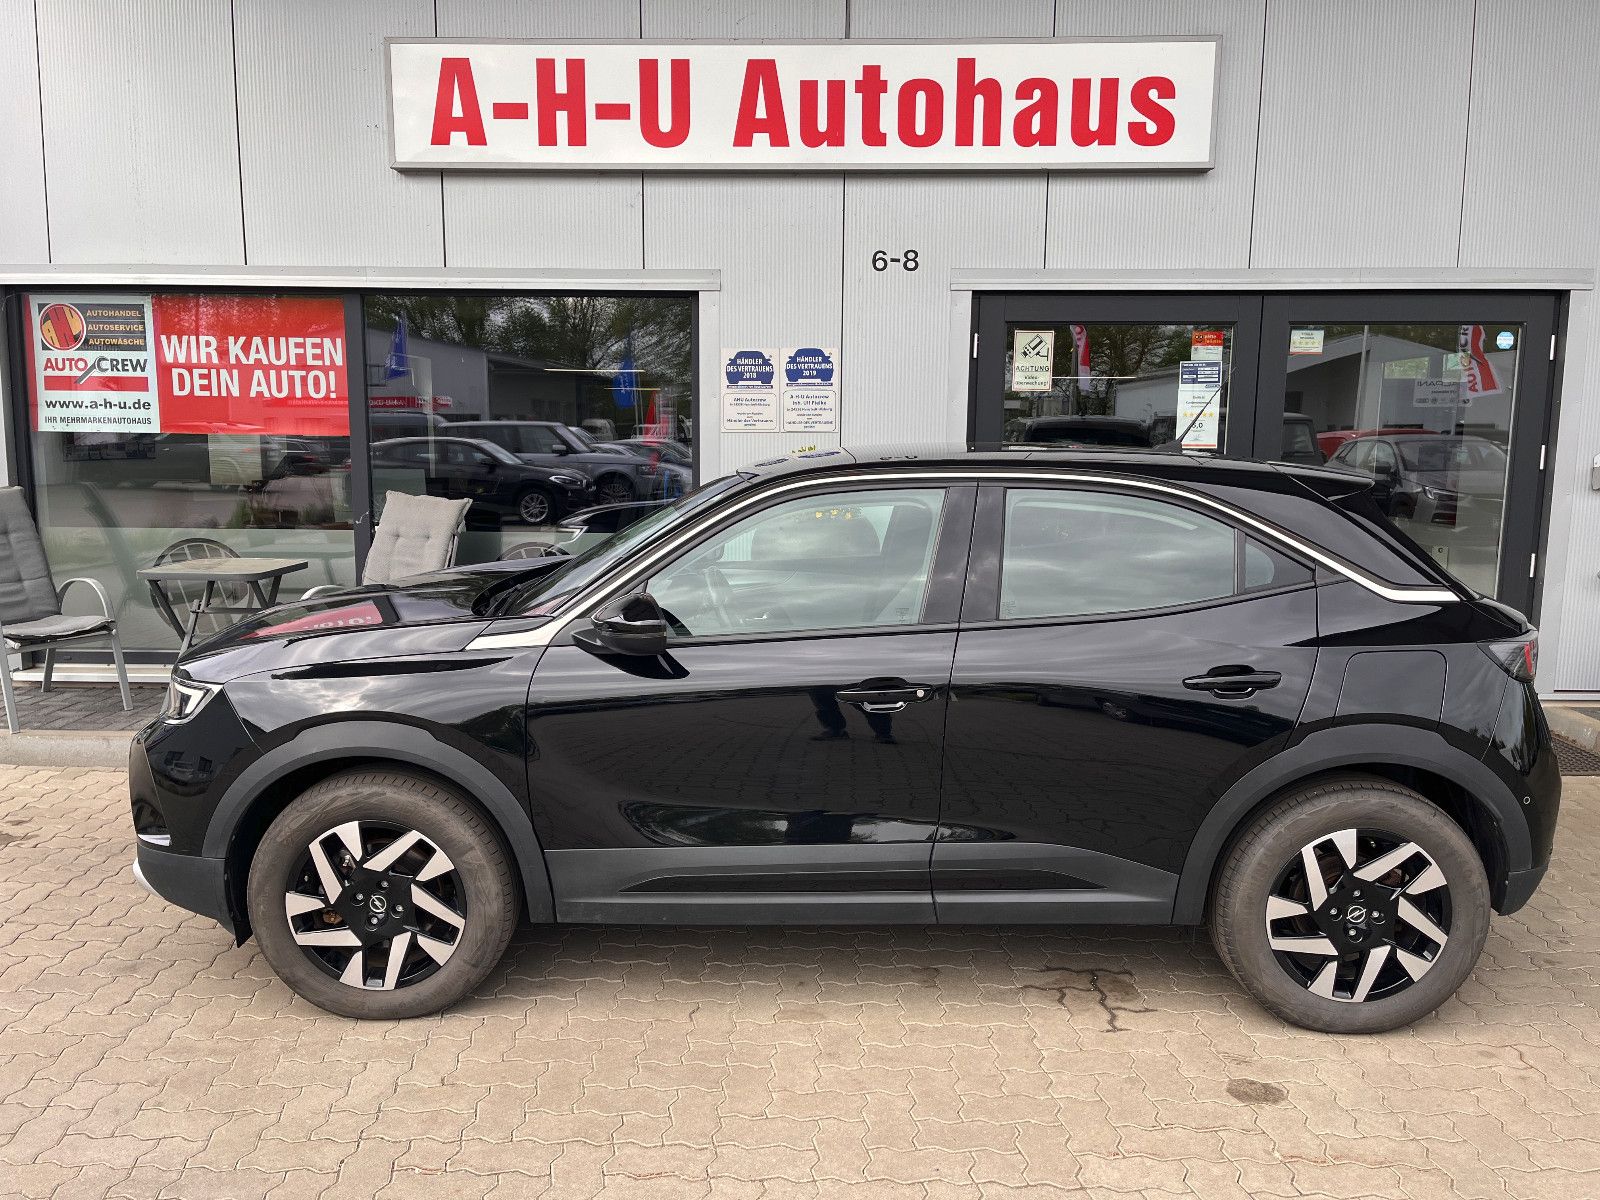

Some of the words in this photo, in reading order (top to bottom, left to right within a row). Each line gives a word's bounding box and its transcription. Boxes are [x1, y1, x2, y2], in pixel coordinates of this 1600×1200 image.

[430, 57, 690, 148] A-H-U
[733, 57, 1176, 148] Autohaus
[871, 249, 920, 272] 6-8
[86, 309, 142, 317] AUTOHANDEL
[160, 334, 218, 364] WIR
[228, 335, 343, 366] KAUFEN
[43, 357, 89, 372] AUTO
[96, 356, 148, 373] CREW
[736, 357, 763, 365] HÄNDLER
[171, 367, 240, 397] DEIN
[249, 369, 337, 399] AUTO!
[45, 398, 152, 411] www.a-h-u.de
[45, 416, 58, 424] IHR
[59, 416, 152, 425] MEHRMARKENAUTOHAUS
